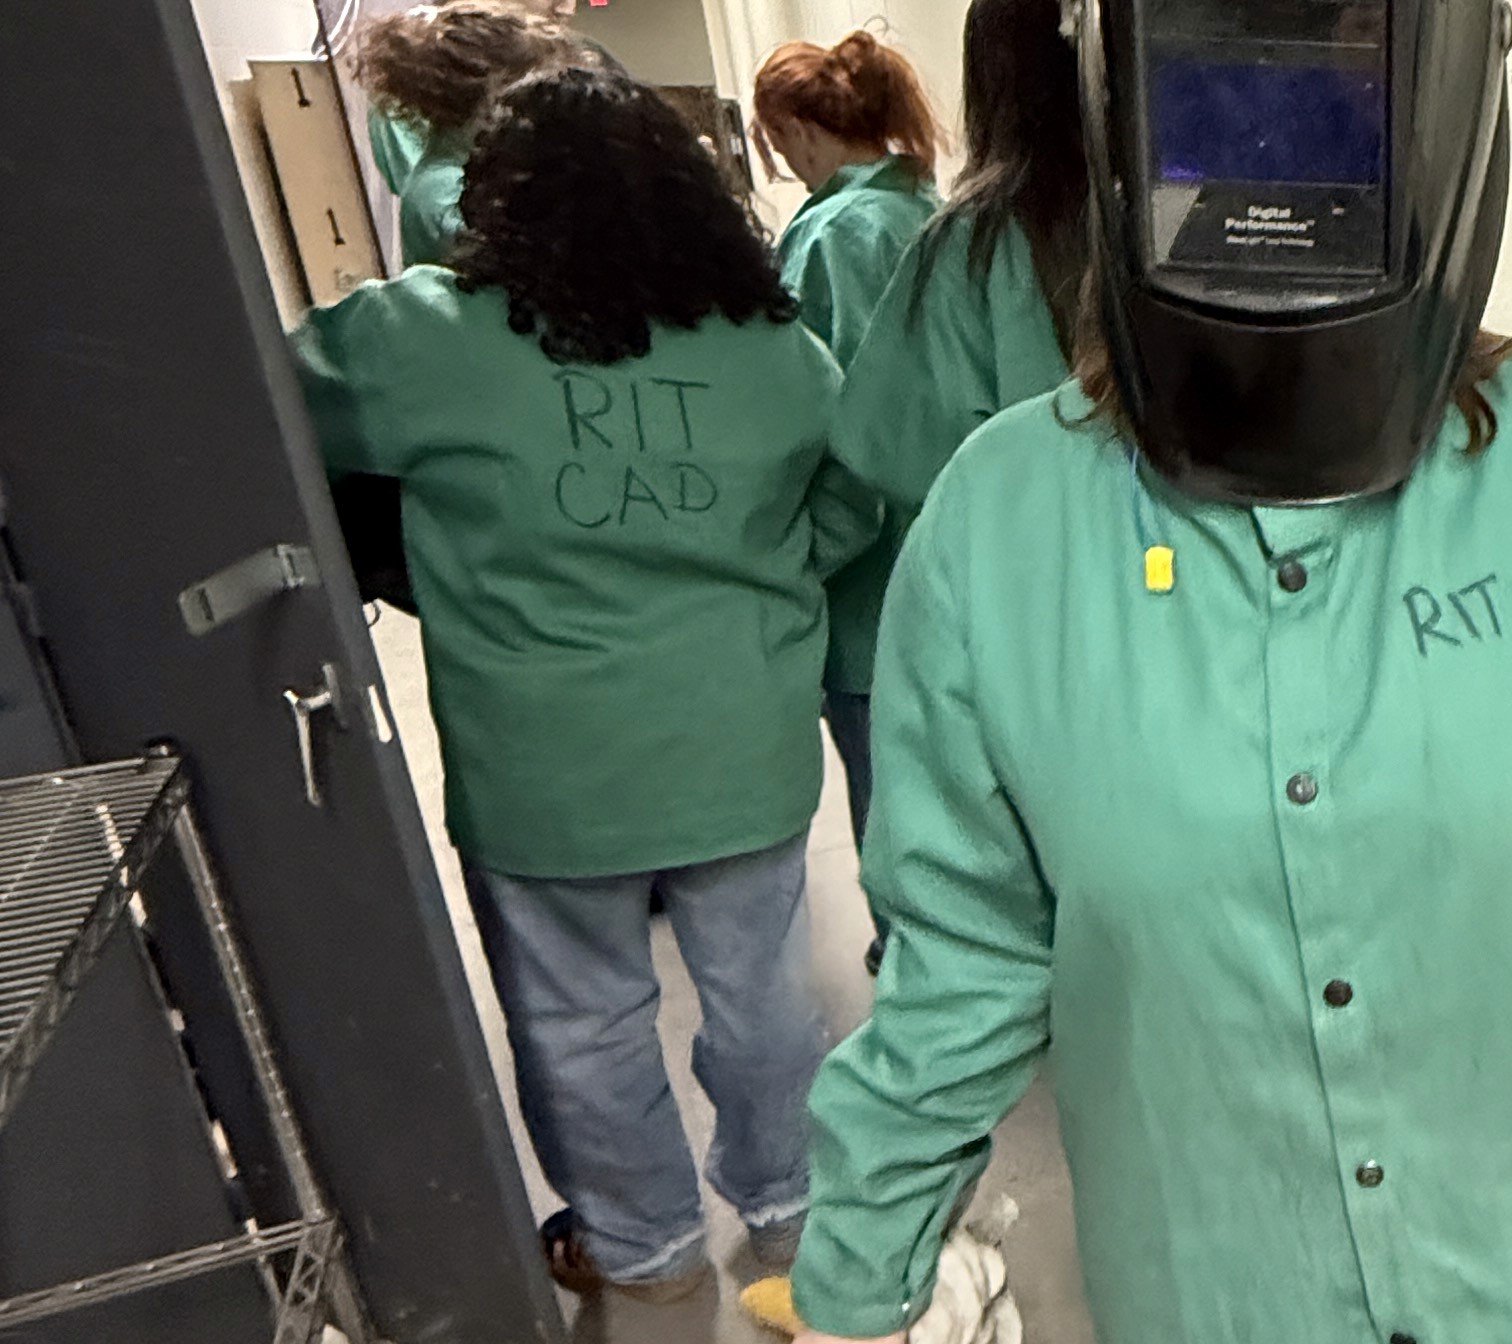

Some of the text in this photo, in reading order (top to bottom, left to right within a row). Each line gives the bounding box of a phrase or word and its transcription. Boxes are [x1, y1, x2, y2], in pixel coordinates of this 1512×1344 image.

[552, 369, 710, 452] RIT
[554, 462, 718, 529] CAD
[1402, 572, 1502, 658] RIT
